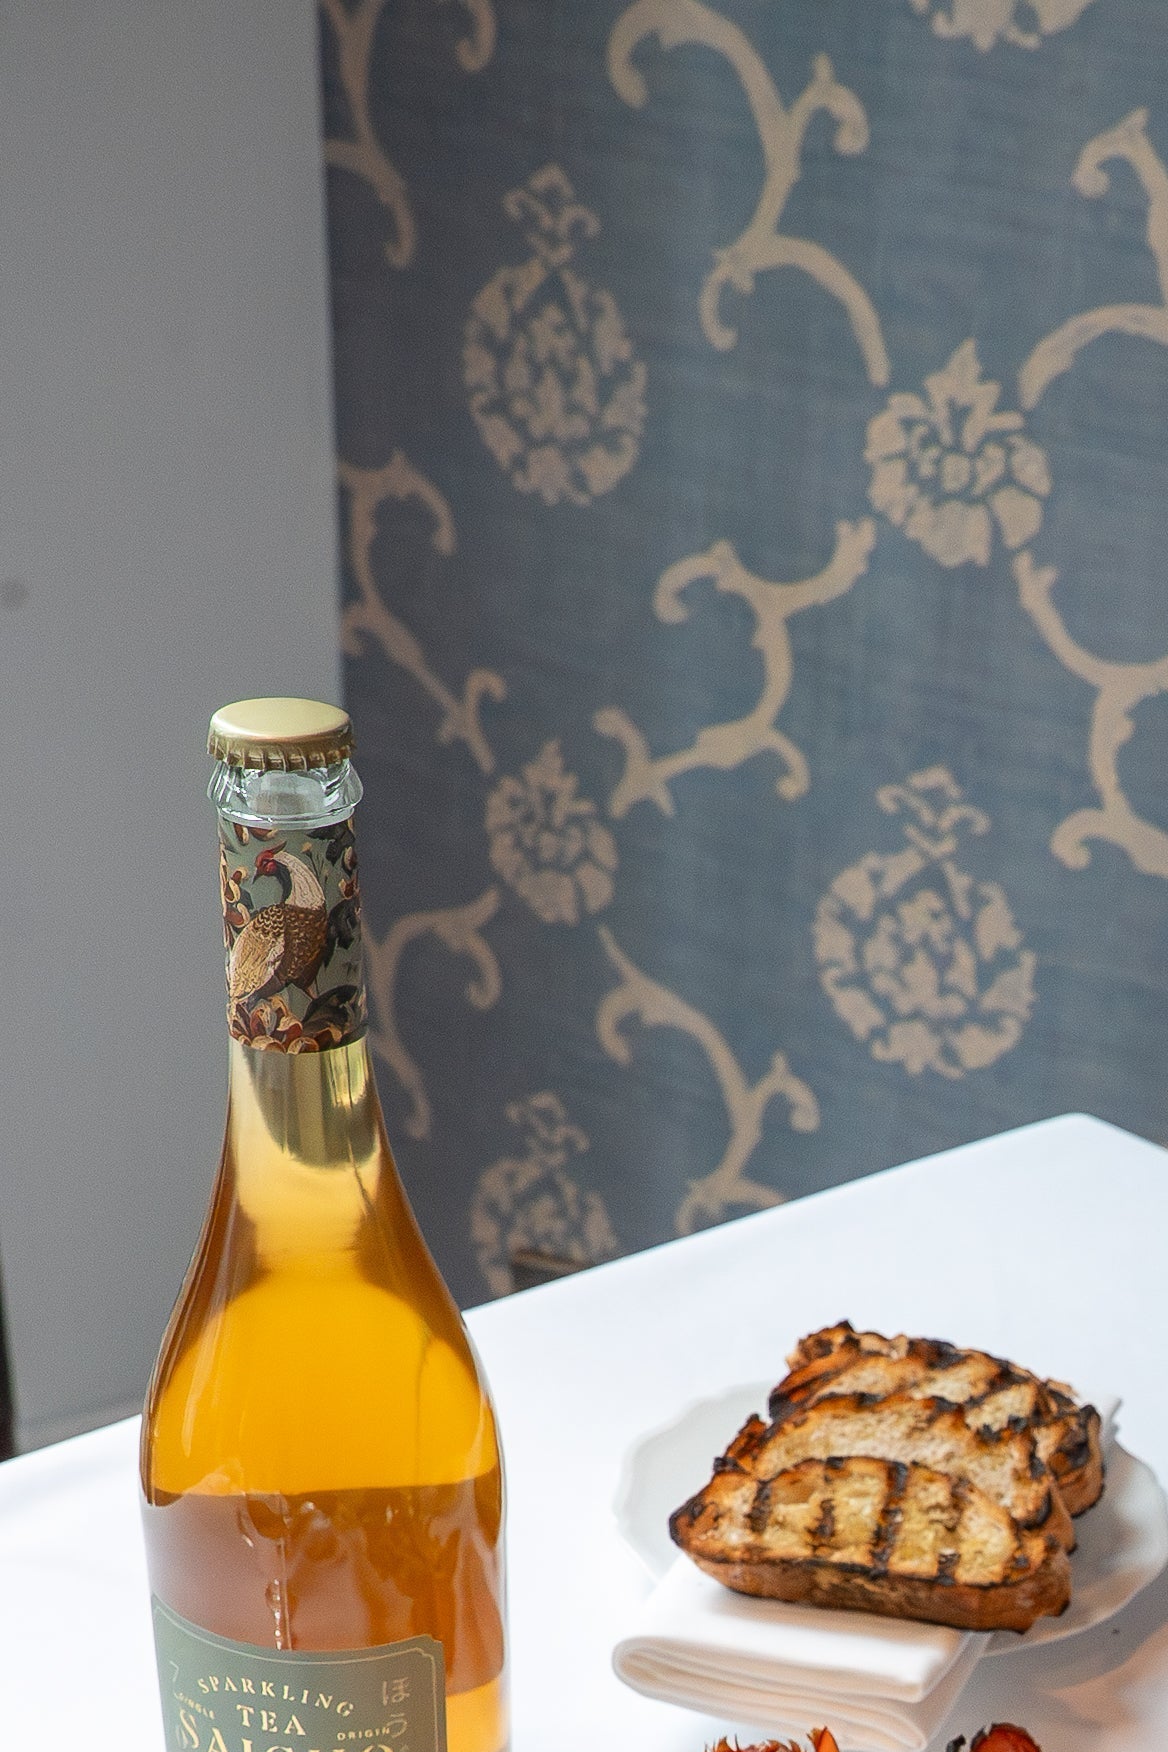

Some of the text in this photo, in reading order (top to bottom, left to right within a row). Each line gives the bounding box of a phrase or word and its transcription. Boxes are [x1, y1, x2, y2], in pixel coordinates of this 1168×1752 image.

[197, 1675, 354, 1718] SPARKLING
[236, 1704, 306, 1736] TEA
[337, 1726, 391, 1741] ORIGIN
